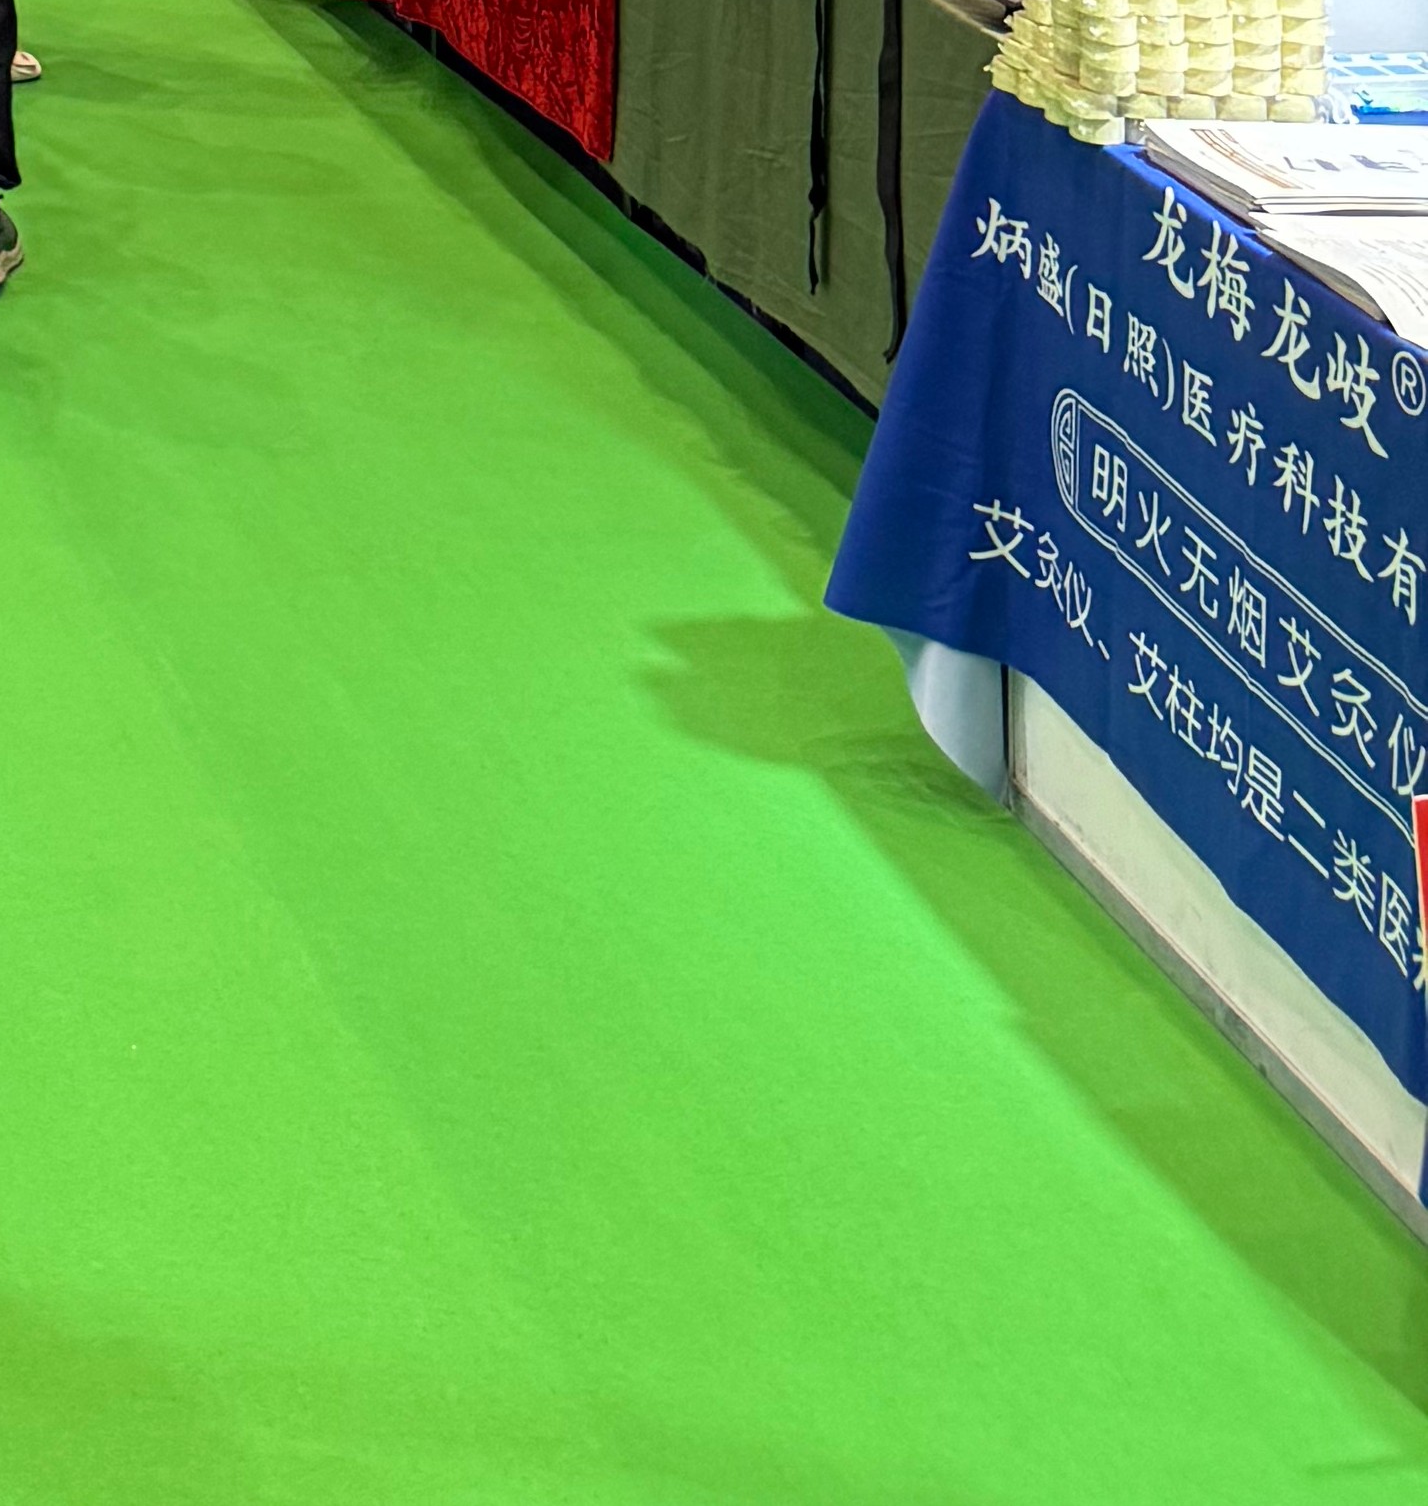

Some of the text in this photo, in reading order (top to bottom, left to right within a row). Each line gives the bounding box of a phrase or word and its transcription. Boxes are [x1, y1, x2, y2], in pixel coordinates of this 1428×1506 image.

[1091, 442, 1427, 796] 明火无烟艾灸仪
